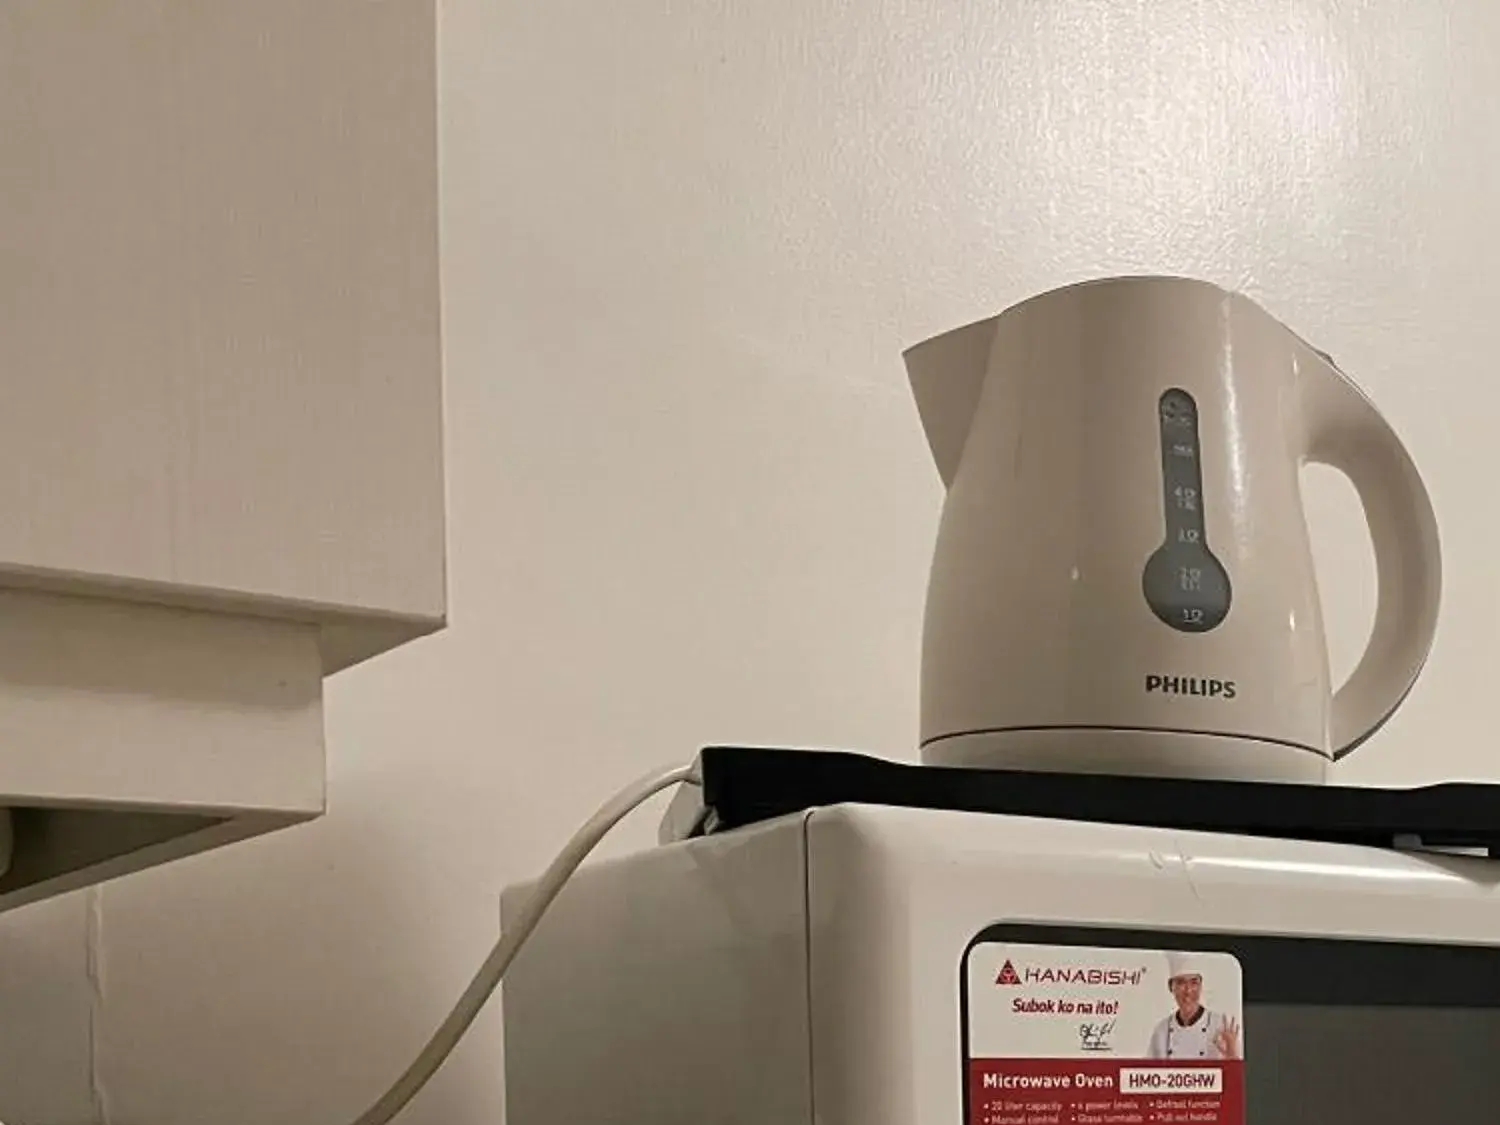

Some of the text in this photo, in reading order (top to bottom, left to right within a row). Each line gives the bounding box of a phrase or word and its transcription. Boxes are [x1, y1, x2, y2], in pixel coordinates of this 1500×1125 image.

[1146, 675, 1236, 698] PHILIPS
[1025, 967, 1141, 985] HANABISHI
[1012, 998, 1119, 1015] Subok ko na ito!
[983, 1073, 1216, 1089] Microwave Oven HMO-20GHW
